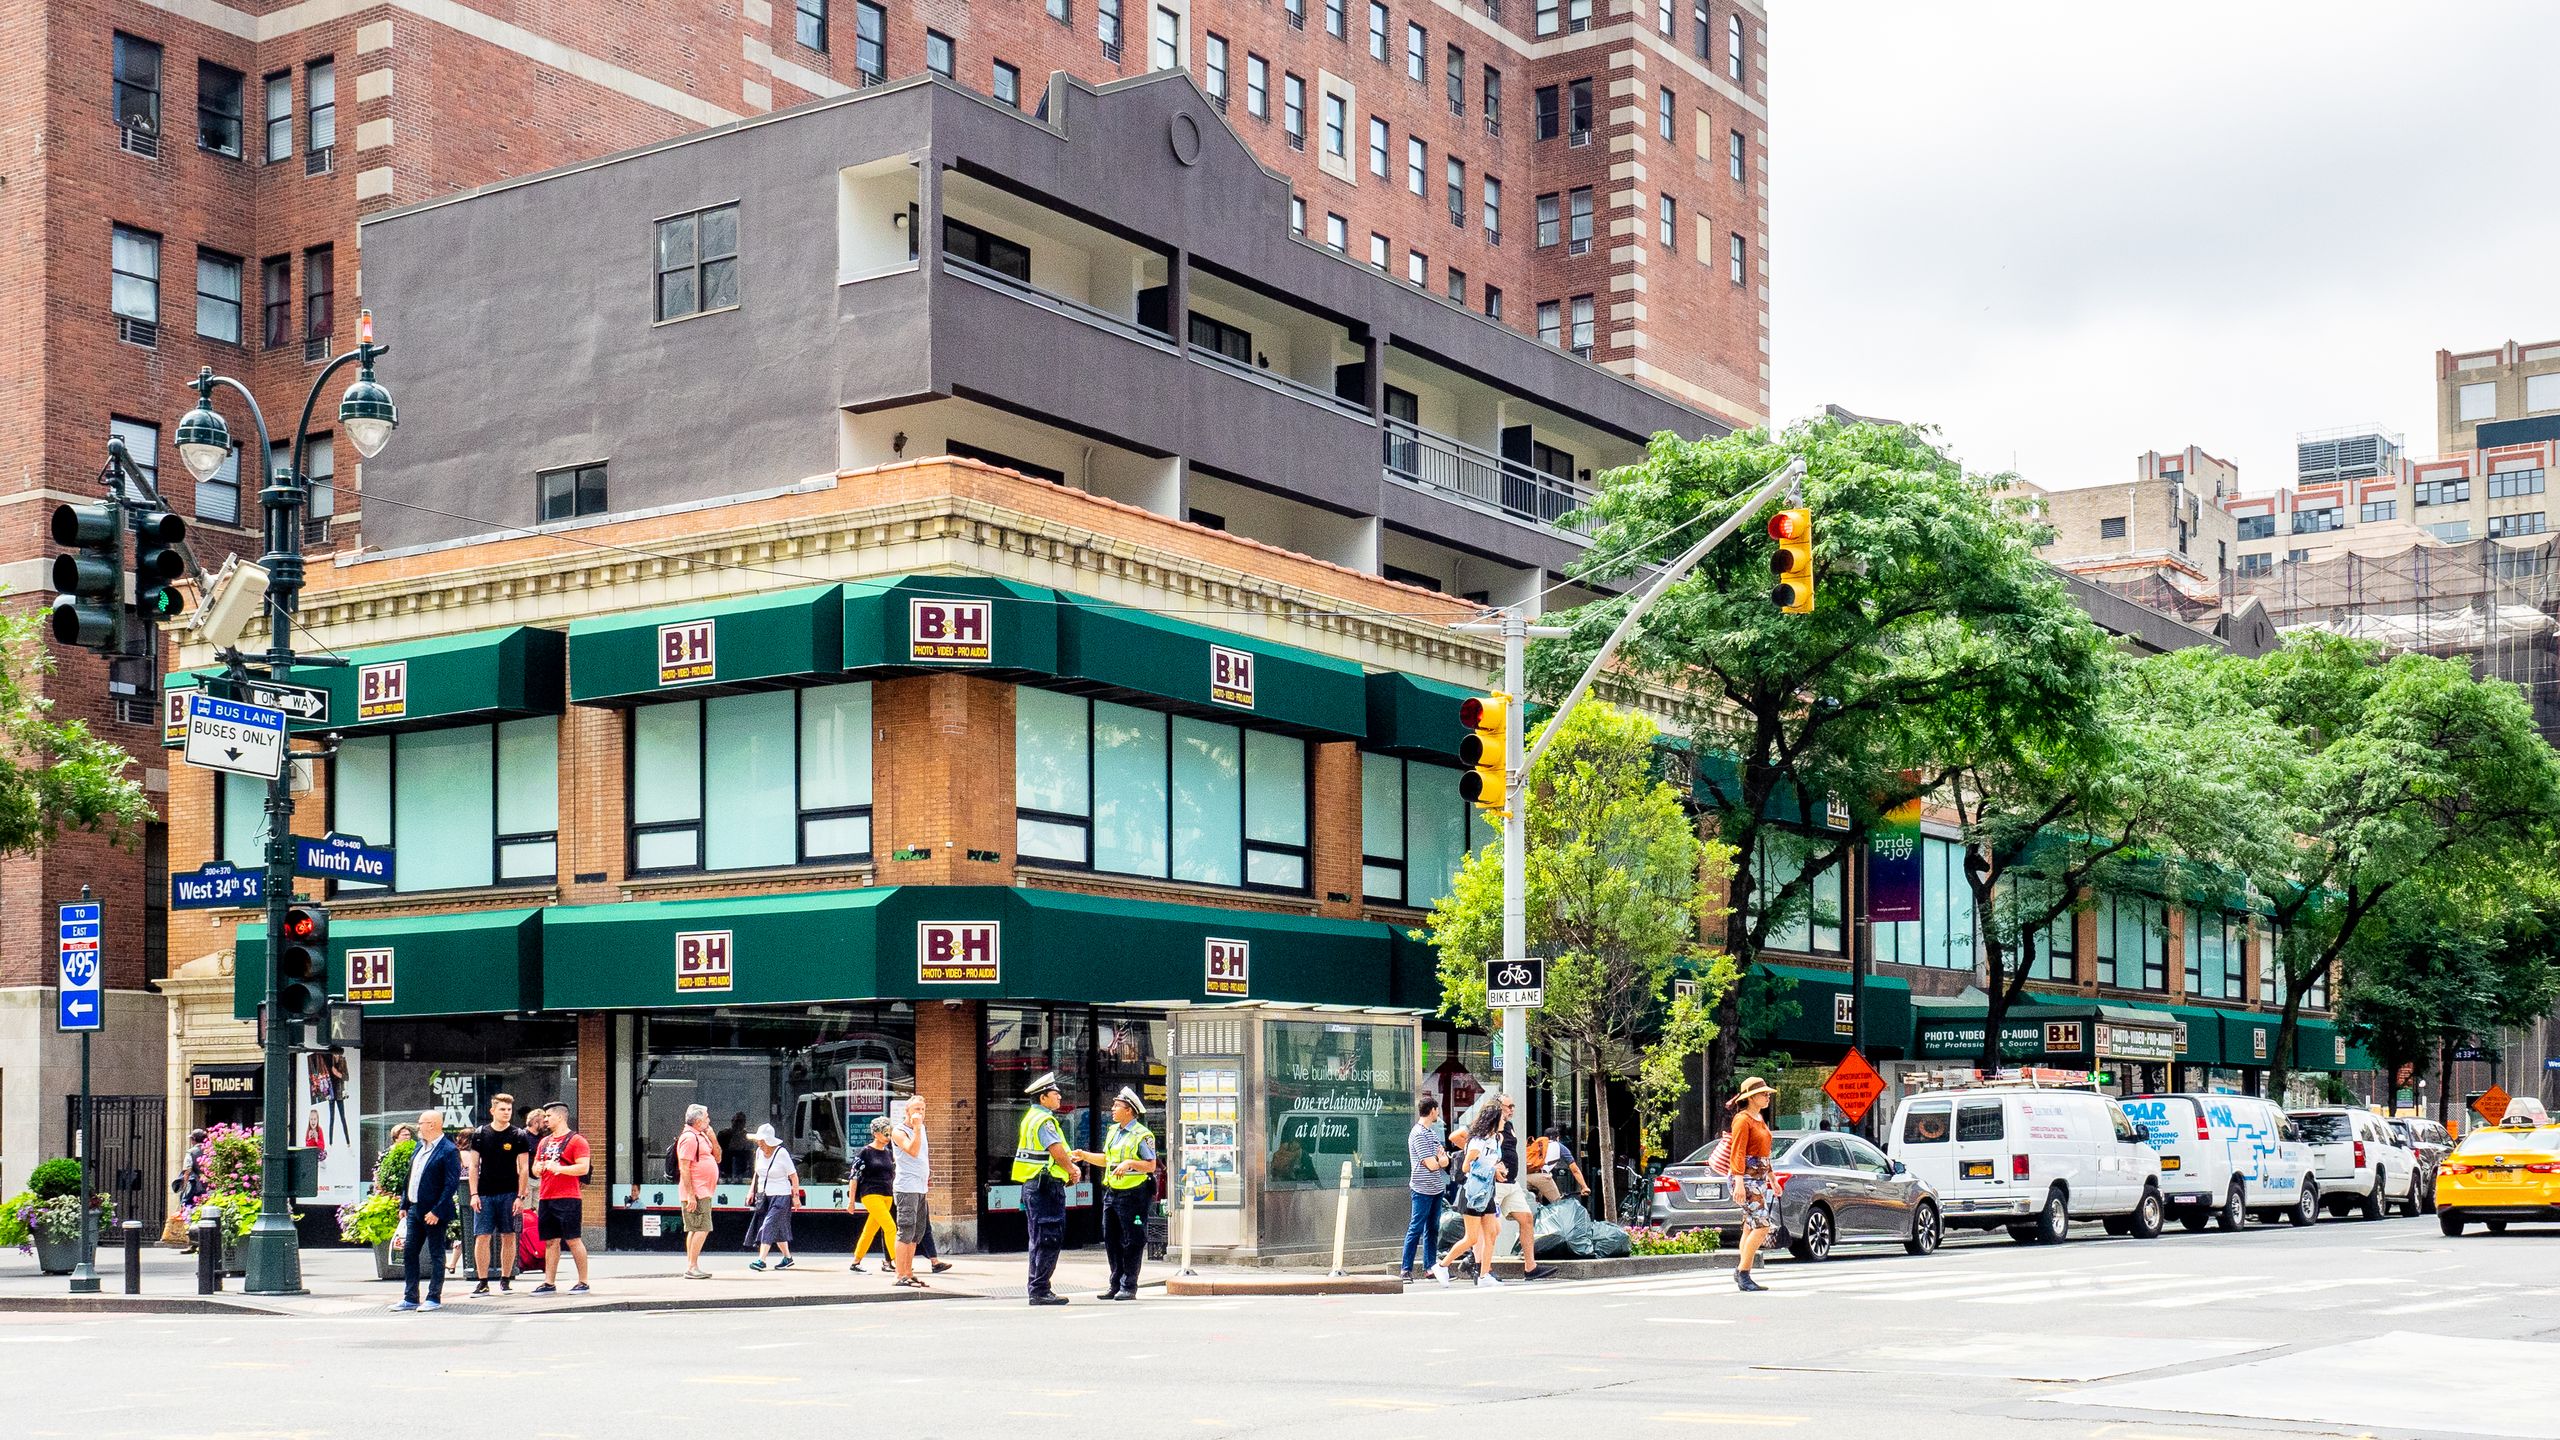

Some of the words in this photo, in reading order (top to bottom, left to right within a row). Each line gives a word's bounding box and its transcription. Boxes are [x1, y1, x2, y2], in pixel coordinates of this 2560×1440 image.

[920, 606, 982, 640] B&H
[666, 628, 708, 663] B&H
[1216, 653, 1249, 688] B&H
[365, 669, 401, 701] B&H
[293, 697, 316, 710] WAY
[215, 705, 240, 719] BUS
[244, 711, 277, 726] LANE
[194, 721, 237, 740] BUSES
[242, 729, 276, 747] ONLY
[1875, 833, 1913, 852] pride
[308, 848, 350, 871] Ninth
[354, 854, 383, 875] Ave
[179, 880, 212, 900] West
[215, 877, 240, 898] 34th
[243, 878, 257, 896] St
[75, 909, 86, 918] TO
[683, 938, 725, 970] B&H
[928, 929, 990, 961] B&H
[65, 952, 95, 978] 495
[352, 955, 388, 984] B&H
[922, 968, 942, 978] PHOTO
[945, 968, 963, 978] VIDEO
[966, 968, 978, 978] PRO
[978, 968, 996, 978] AUDIO
[1490, 991, 1510, 1003] BIKE
[1515, 990, 1539, 1002] LANE
[1167, 1028, 1175, 1057] News
[1292, 1064, 1309, 1081] We
[1311, 1065, 1333, 1081] build
[1351, 1066, 1390, 1082] business
[211, 1077, 253, 1092] TRADE-IN
[433, 1076, 474, 1095] SAVE
[851, 1080, 882, 1093] PICKUP
[441, 1093, 464, 1106] THE
[851, 1093, 883, 1104] IN-STORE
[1294, 1096, 1315, 1110] one
[1317, 1089, 1384, 1117] relationship
[1837, 1092, 1859, 1100] PROCEED
[1295, 1121, 1308, 1138] at
[1309, 1124, 1318, 1138] a
[1321, 1119, 1350, 1138] time.
